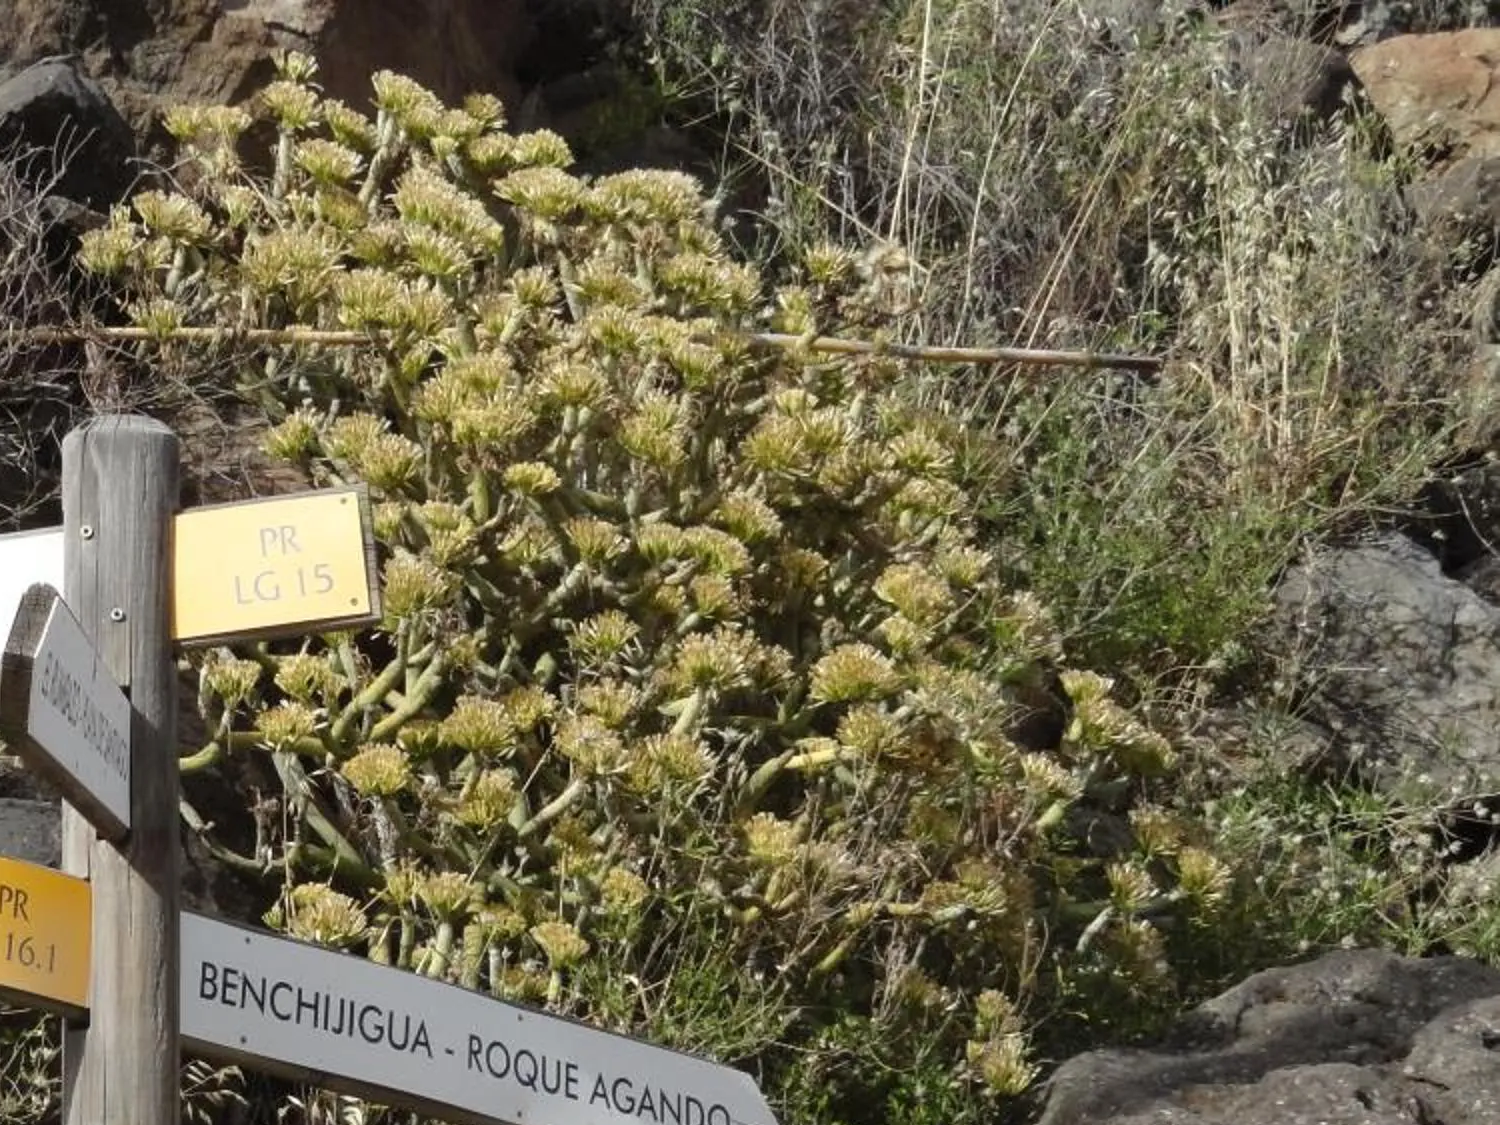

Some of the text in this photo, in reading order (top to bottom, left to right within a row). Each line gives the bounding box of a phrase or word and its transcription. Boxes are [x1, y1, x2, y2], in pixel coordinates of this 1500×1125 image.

[259, 525, 301, 557] PR
[234, 563, 334, 605] LG 15
[5, 933, 56, 973] 16.1
[199, 961, 434, 1059] BENCHIJIGUA
[467, 1034, 579, 1100] ROQUE
